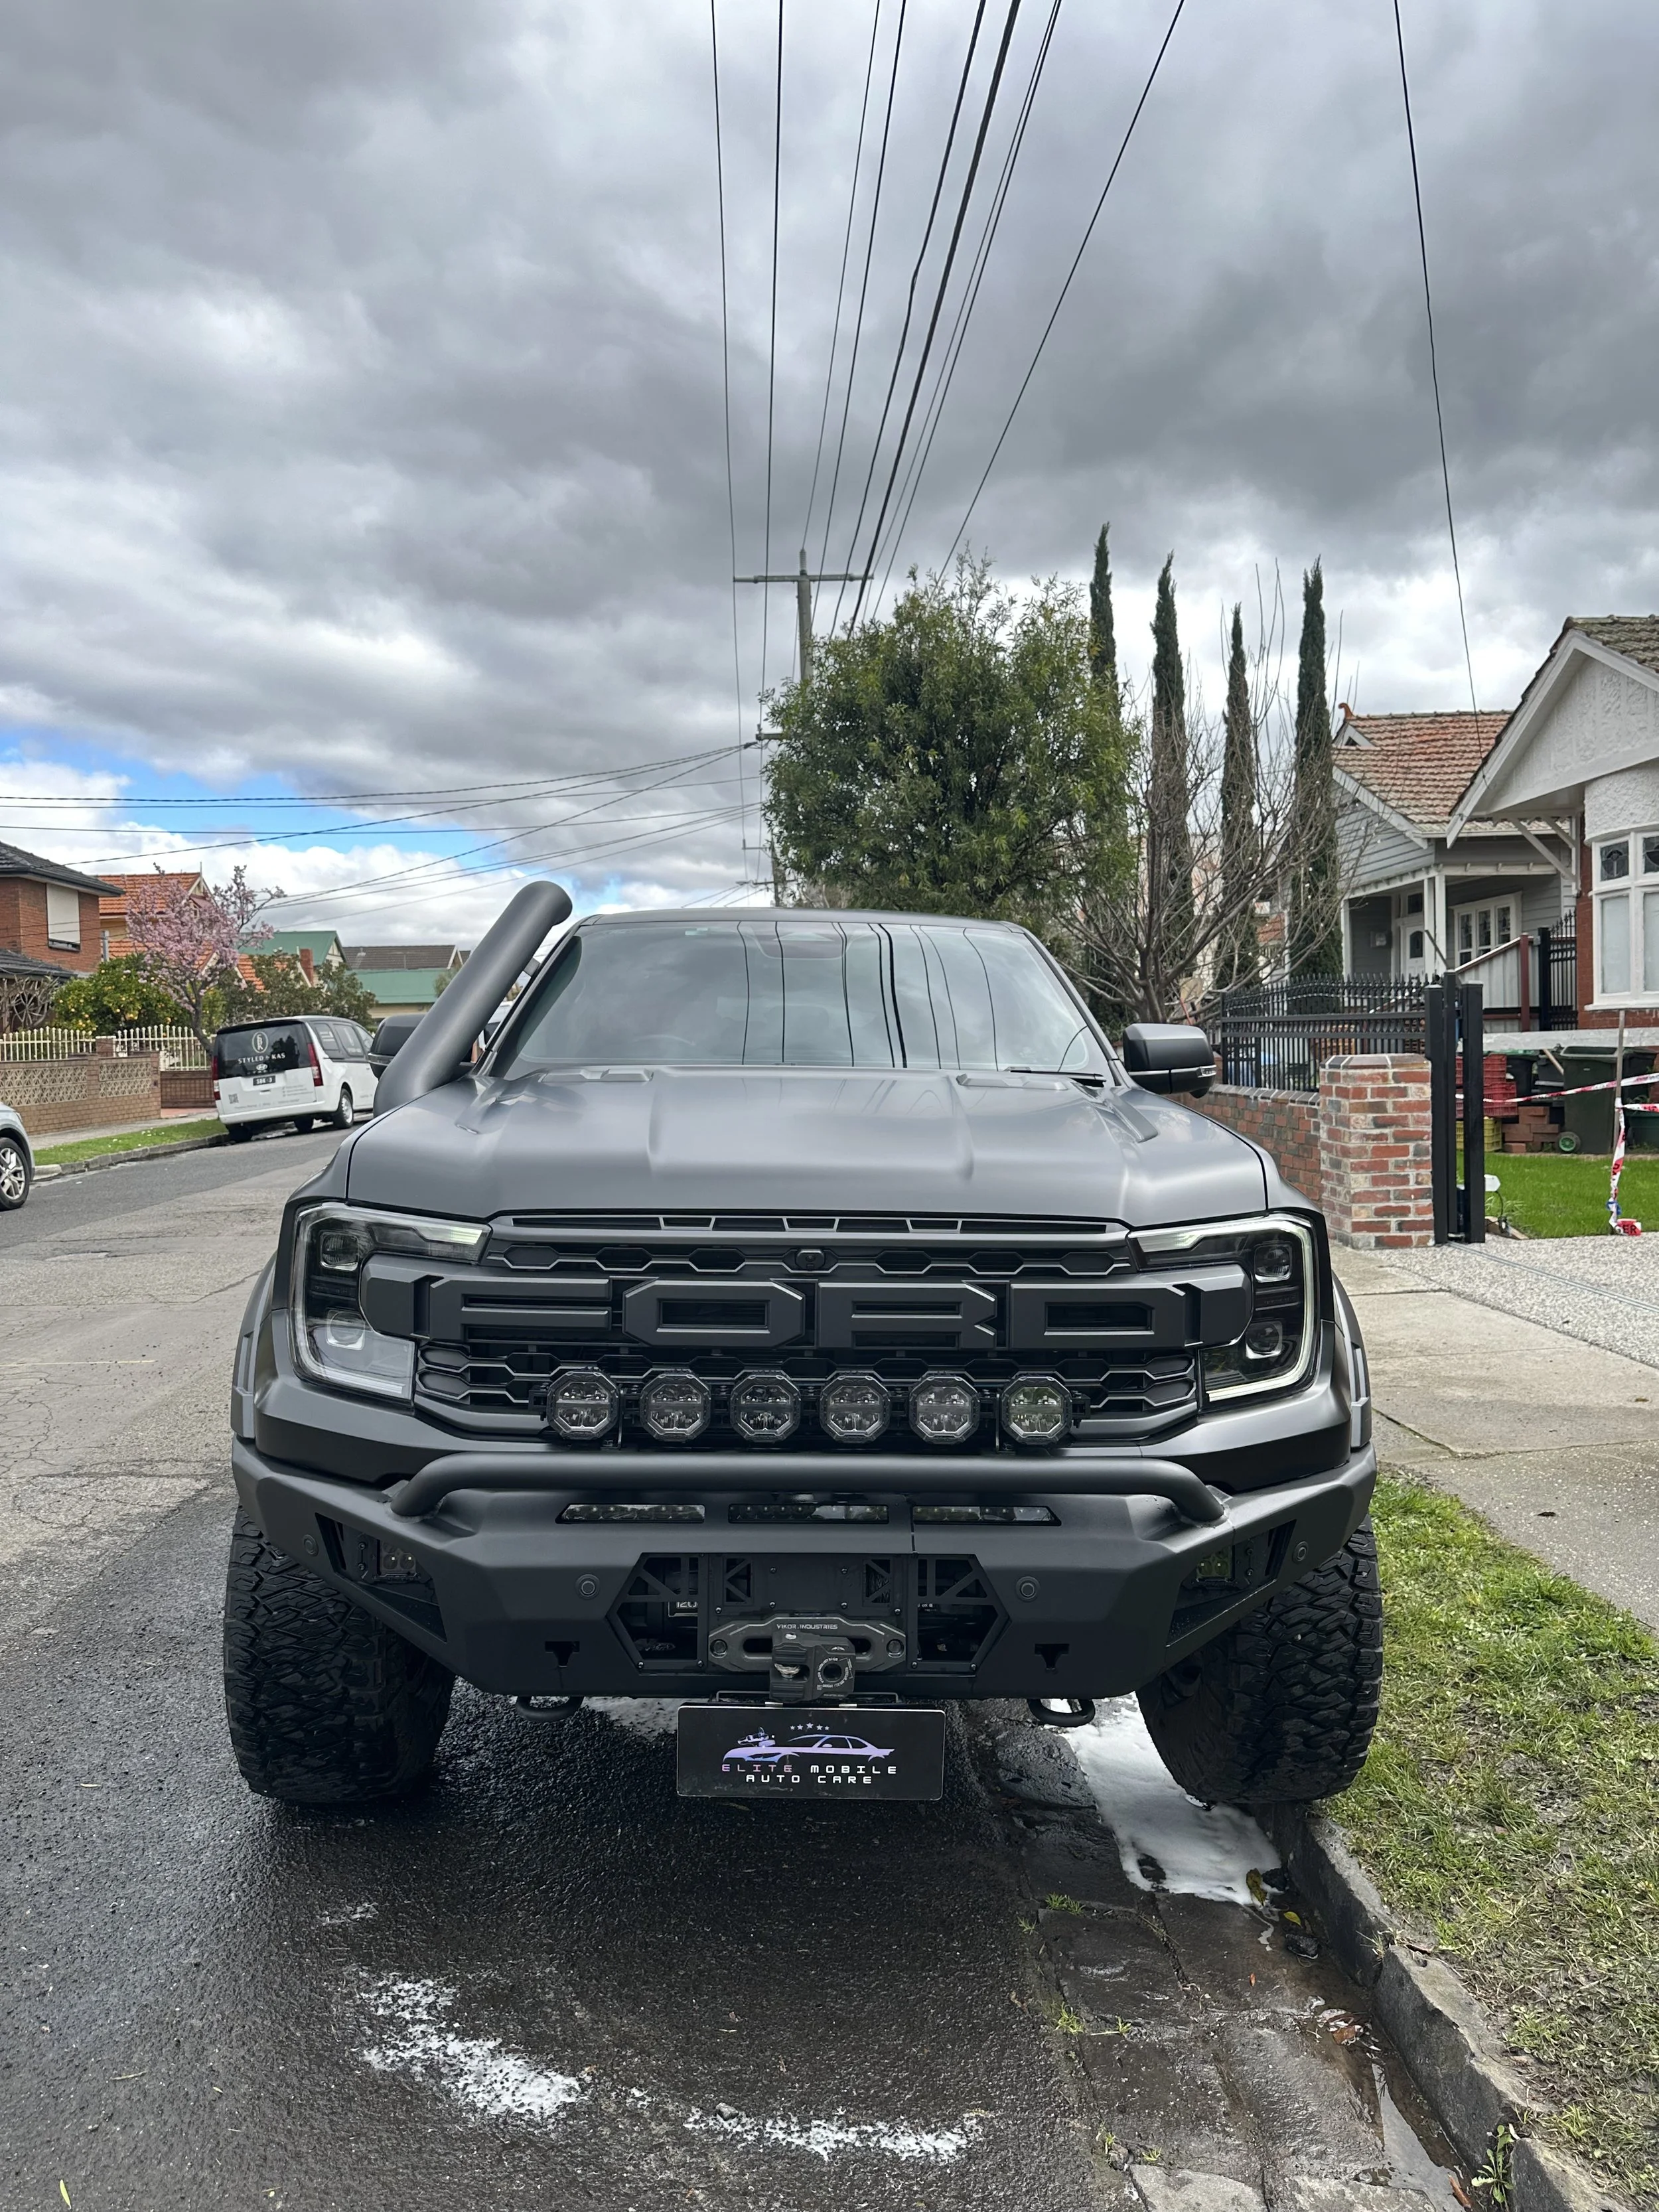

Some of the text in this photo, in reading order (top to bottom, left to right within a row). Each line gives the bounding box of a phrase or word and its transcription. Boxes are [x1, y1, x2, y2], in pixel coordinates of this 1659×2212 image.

[238, 1055, 264, 1065] STYLED
[430, 1278, 1186, 1349] FORD
[721, 1763, 897, 1775] ELITE MOBILE
[746, 1774, 872, 1784] AUTO CARE
